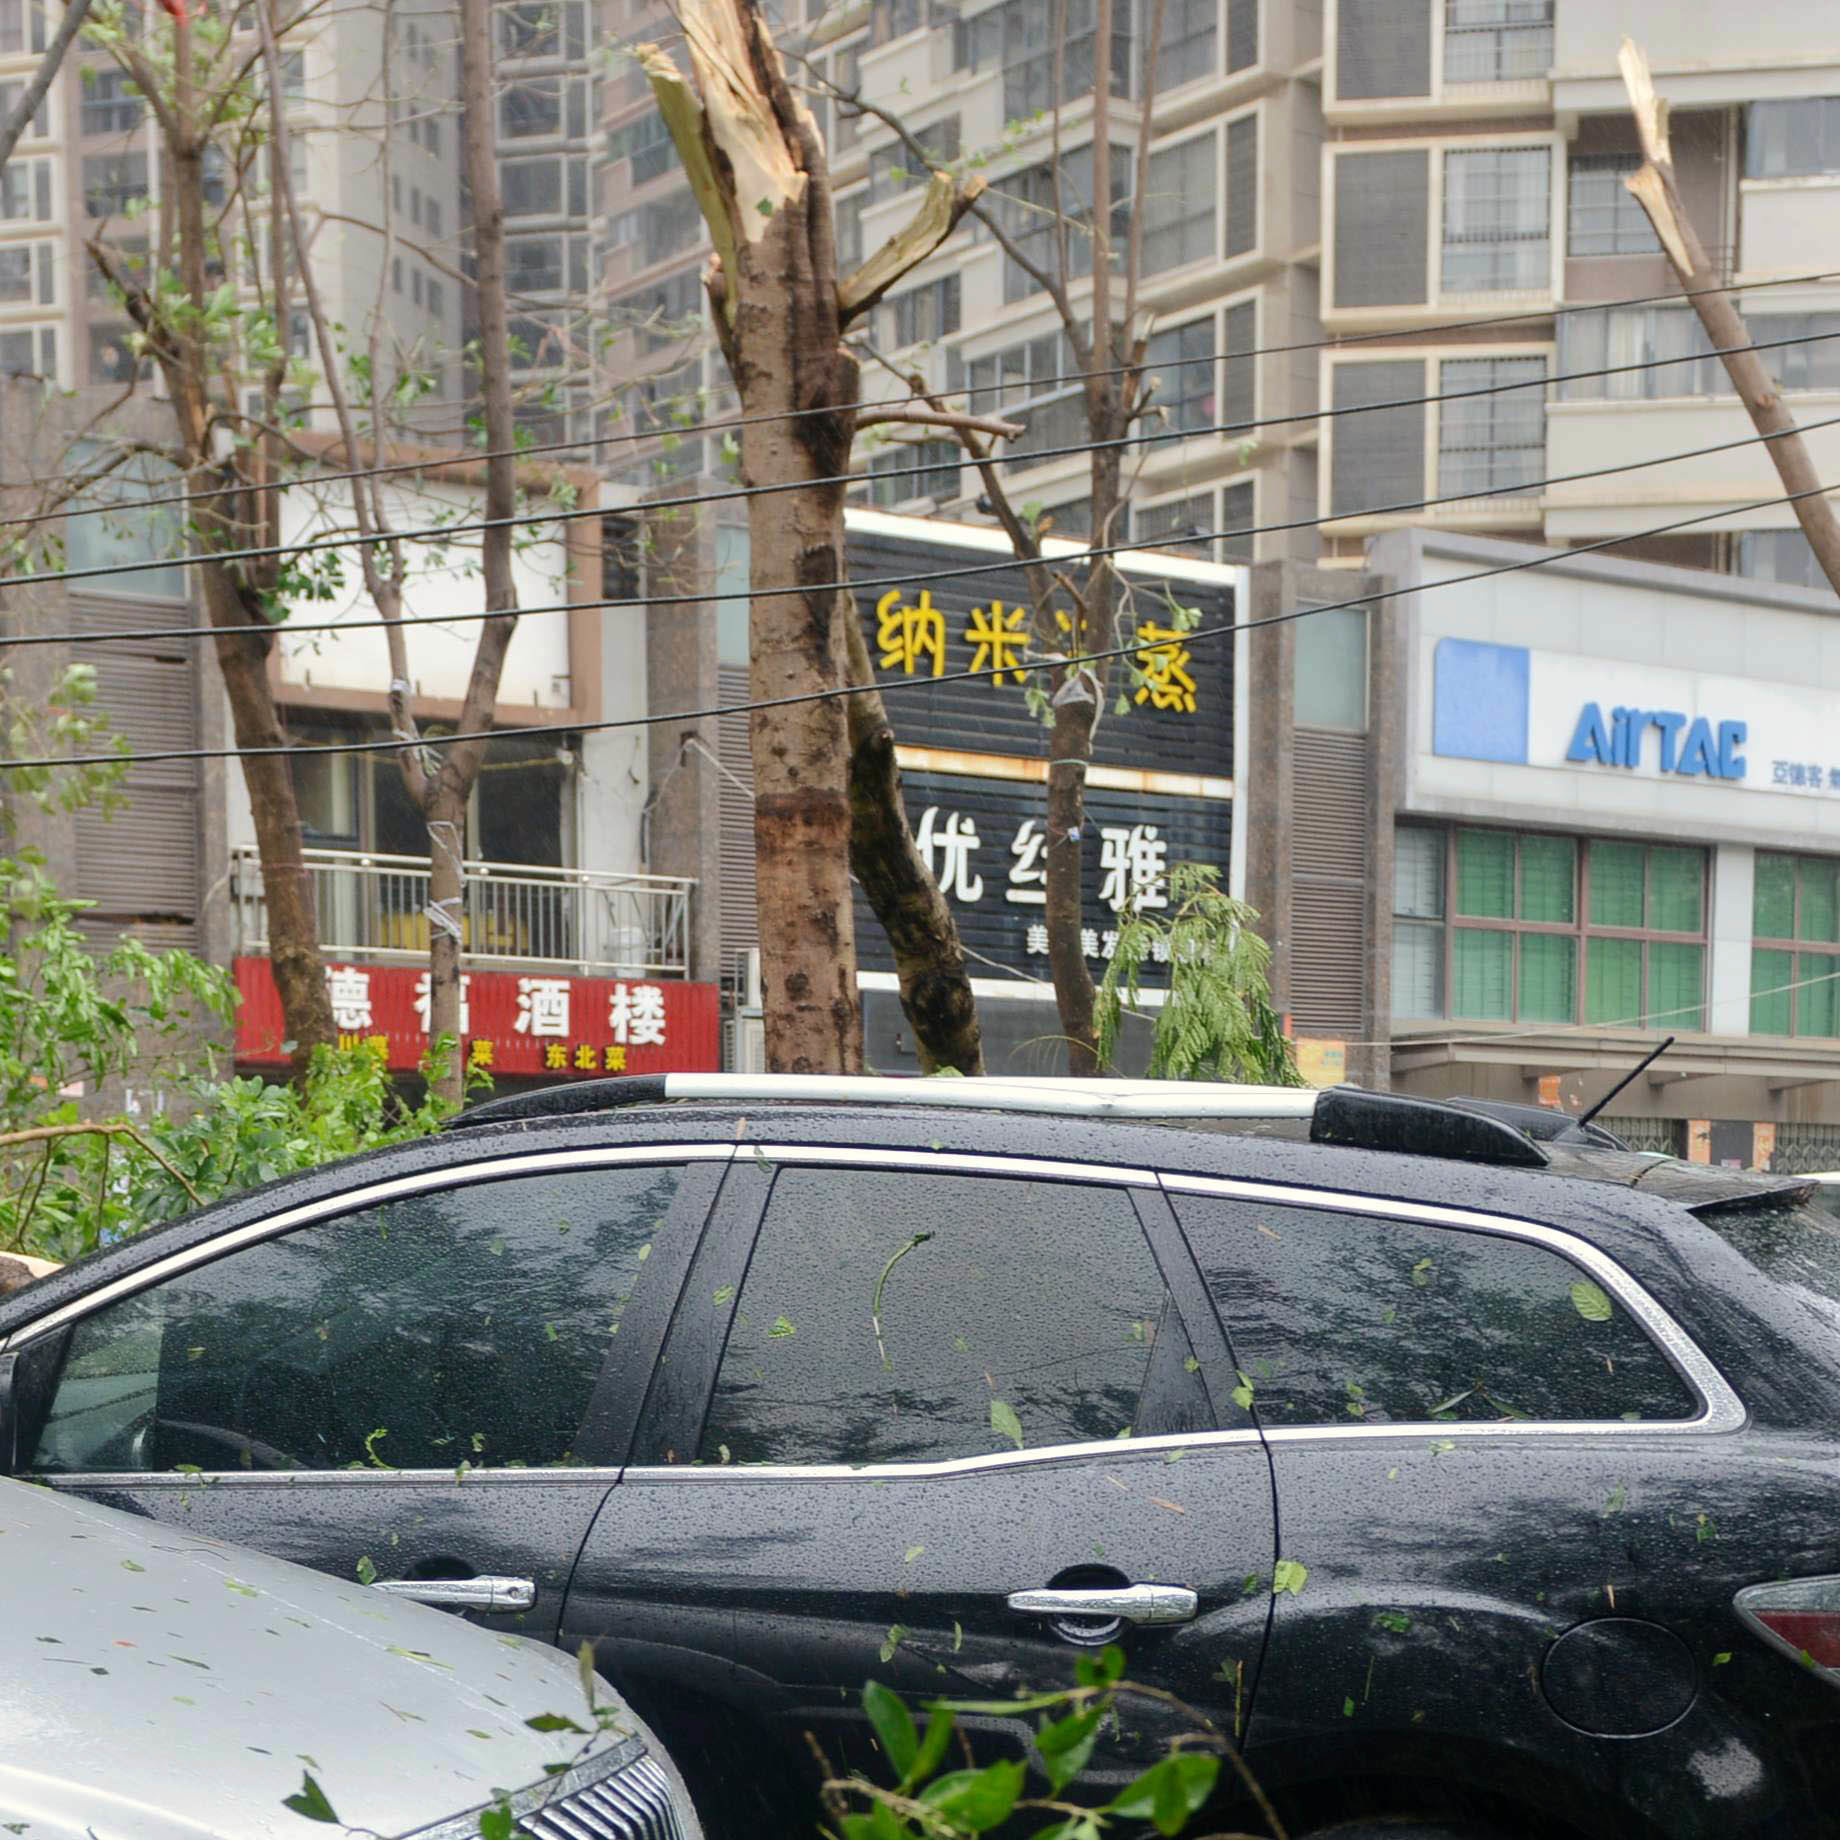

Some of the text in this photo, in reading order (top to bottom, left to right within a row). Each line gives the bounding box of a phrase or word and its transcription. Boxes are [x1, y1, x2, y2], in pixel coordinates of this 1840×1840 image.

[876, 588, 1197, 714] 纳米蒸
[1565, 701, 1748, 782] AirTAC
